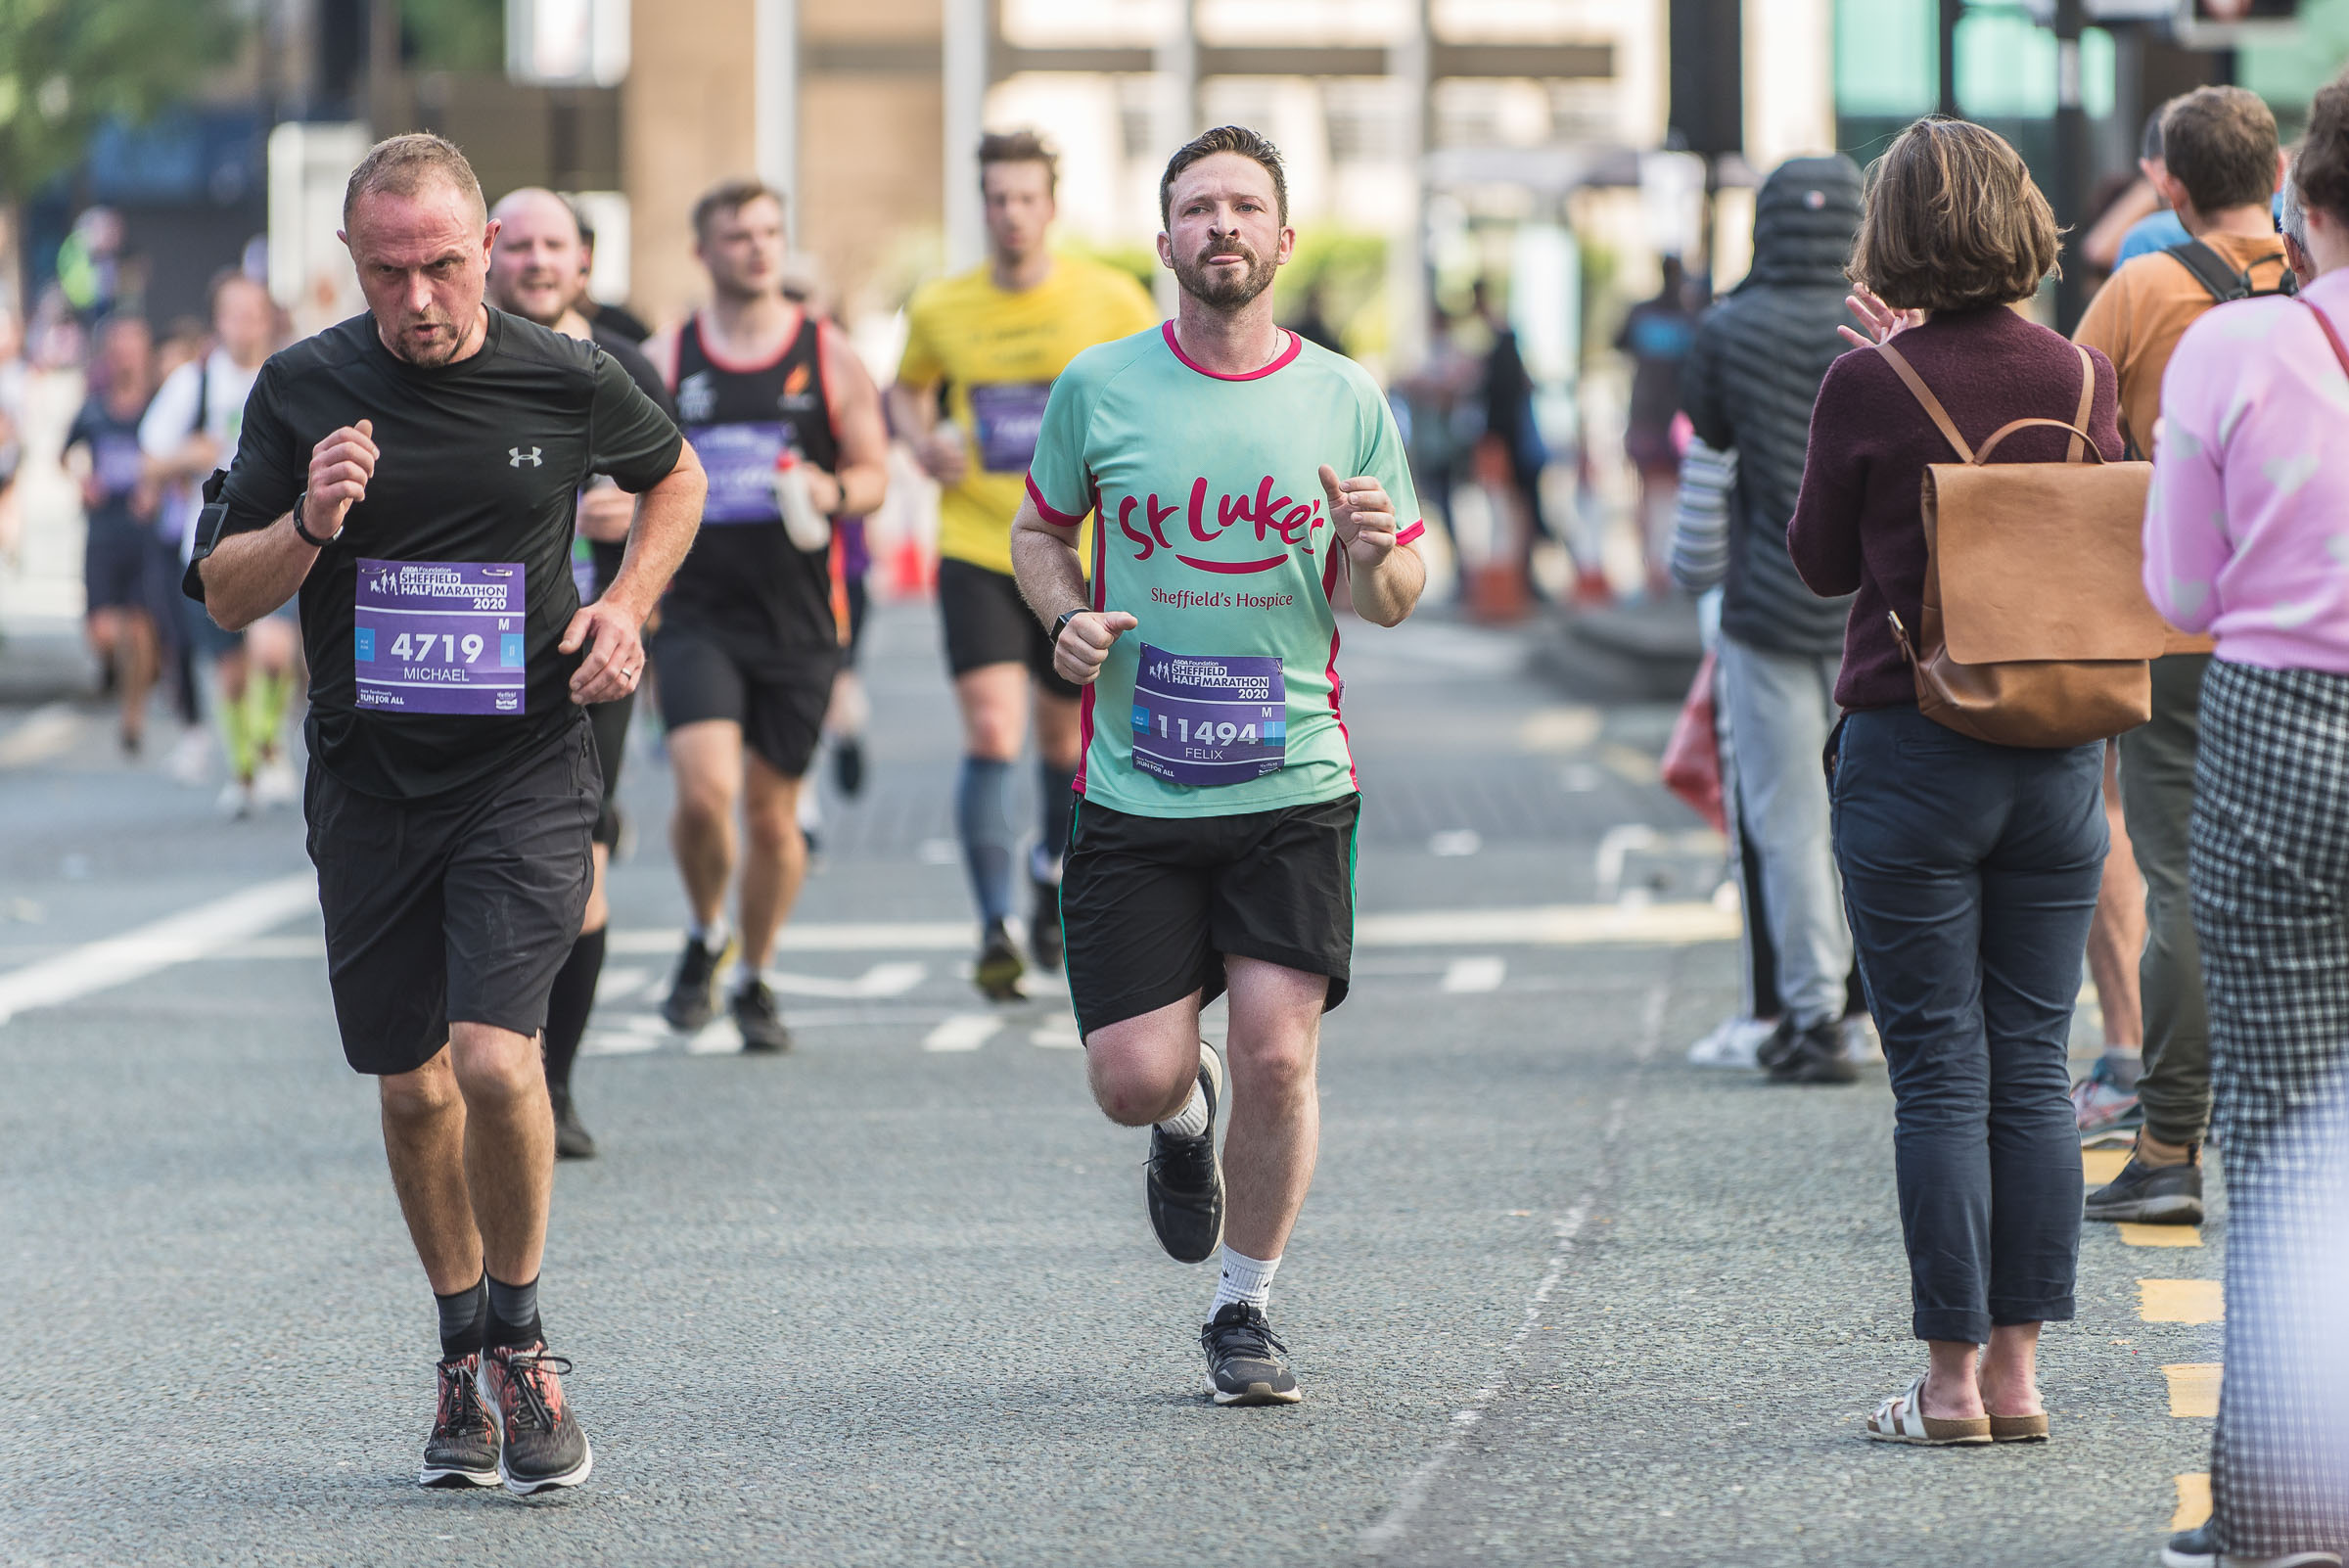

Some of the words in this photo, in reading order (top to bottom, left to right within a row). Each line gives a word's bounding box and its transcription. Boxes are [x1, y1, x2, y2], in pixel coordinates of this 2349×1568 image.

[1118, 492, 1180, 561] St
[401, 574, 459, 584] SHEFFIELD
[400, 584, 432, 596] HALF
[434, 585, 506, 596] MARATHON
[473, 597, 507, 610] 2020
[1150, 587, 1231, 610] Sheffield's
[1236, 591, 1293, 611] Hospice
[497, 618, 510, 631] M
[390, 632, 484, 665] 4719
[403, 667, 470, 682] MICHAEL
[1173, 665, 1225, 676] SHEFFIELD
[1173, 674, 1201, 686] HALF
[1202, 677, 1268, 687] MARATHON
[391, 696, 404, 705] ALL
[1237, 688, 1269, 700] 2020
[1261, 706, 1273, 718] M
[1157, 714, 1259, 747] 11494
[1185, 747, 1224, 761] FELIX
[1162, 768, 1175, 777] ALL
